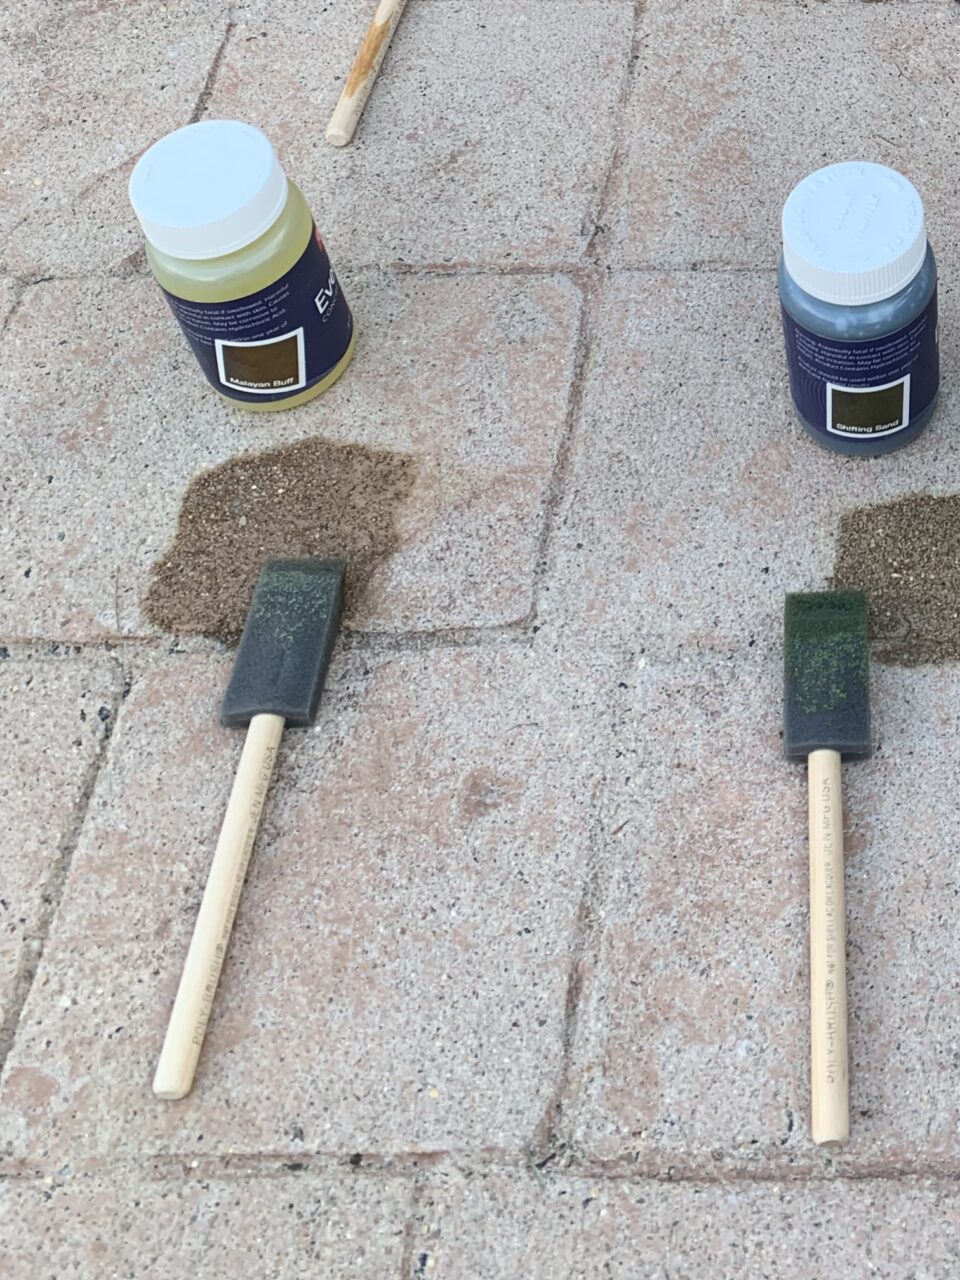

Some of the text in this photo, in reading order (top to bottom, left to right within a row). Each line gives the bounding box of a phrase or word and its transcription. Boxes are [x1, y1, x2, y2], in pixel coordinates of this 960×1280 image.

[229, 377, 294, 388] Malayan Buff
[836, 419, 899, 433] Shifting Sand
